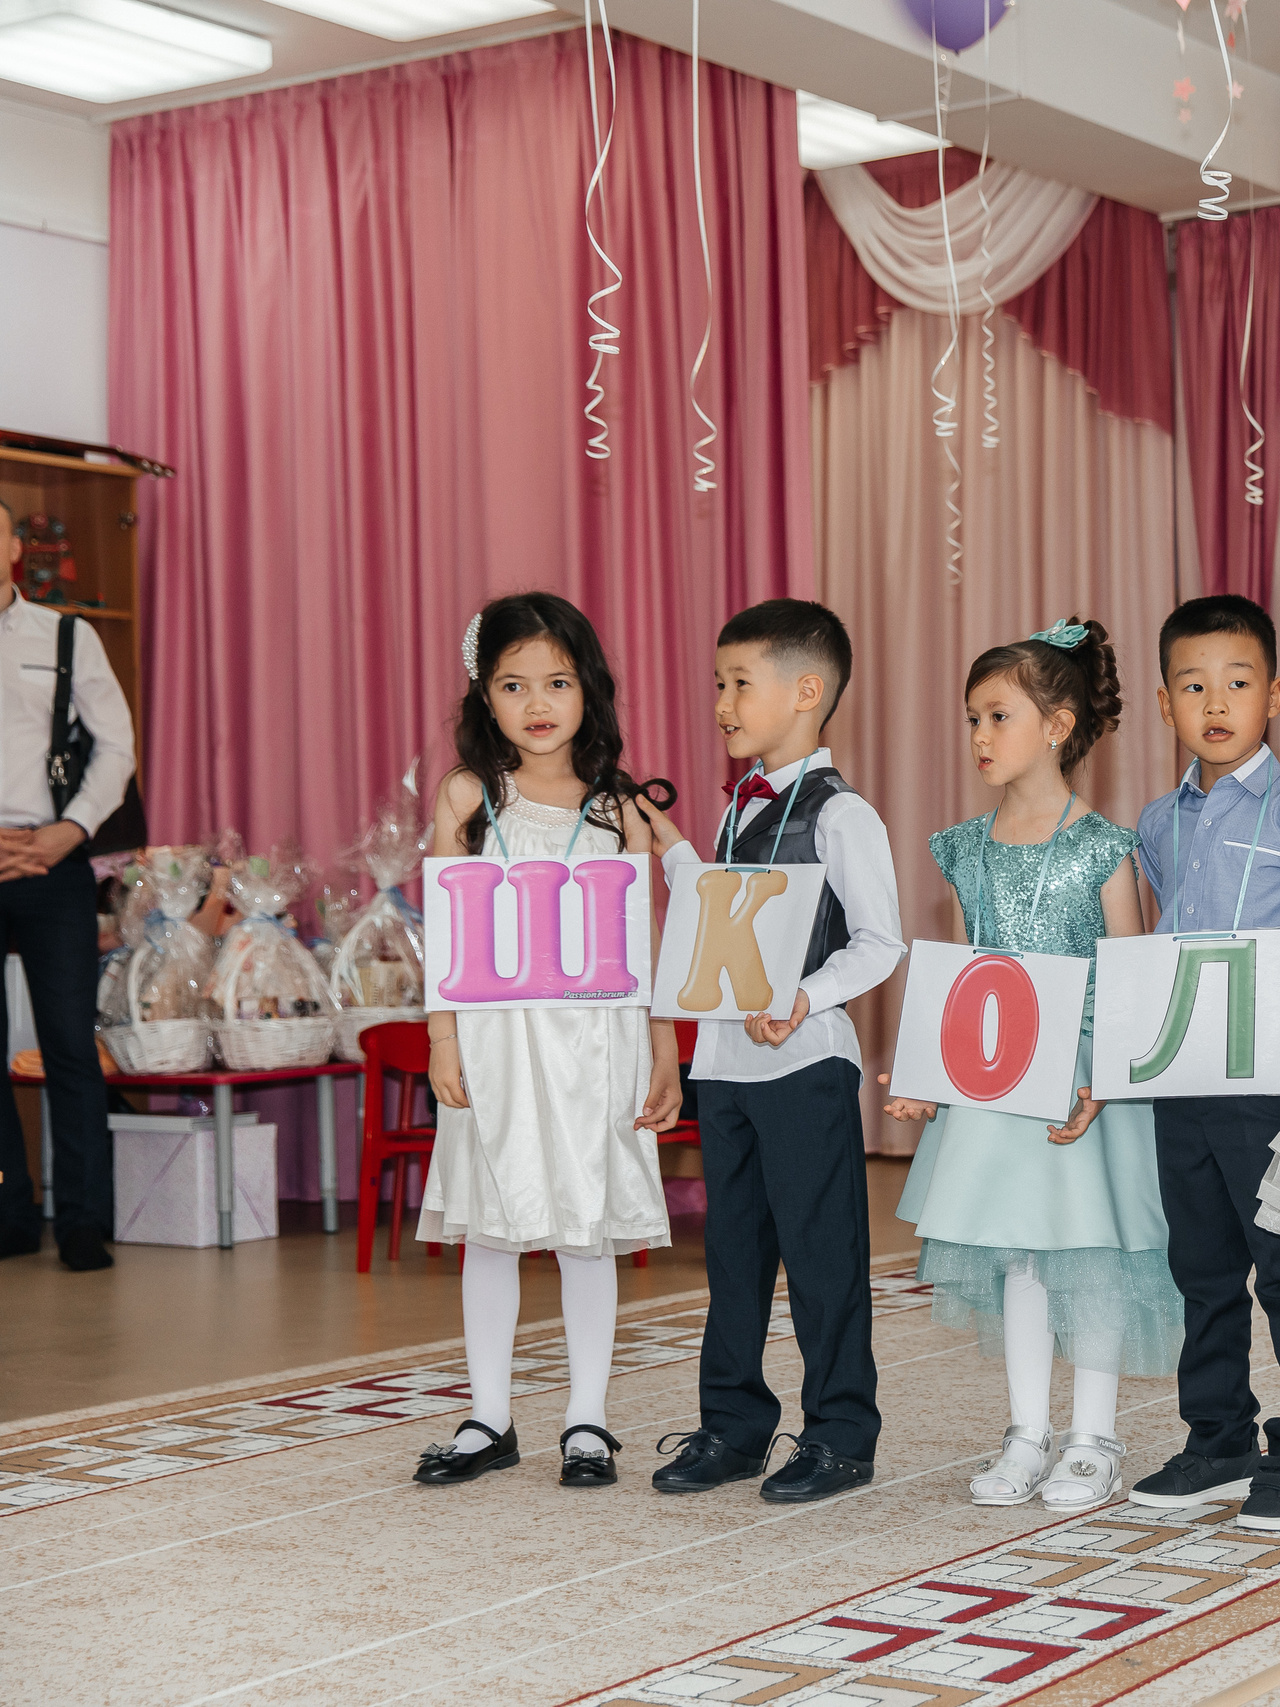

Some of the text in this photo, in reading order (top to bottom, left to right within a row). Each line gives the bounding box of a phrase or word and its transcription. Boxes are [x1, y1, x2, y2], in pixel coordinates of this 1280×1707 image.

[438, 860, 638, 1001] Ш
[562, 989, 639, 999] PassionForum.ru
[676, 869, 789, 1012] К
[940, 954, 1040, 1102] О
[1129, 939, 1256, 1084] Л
